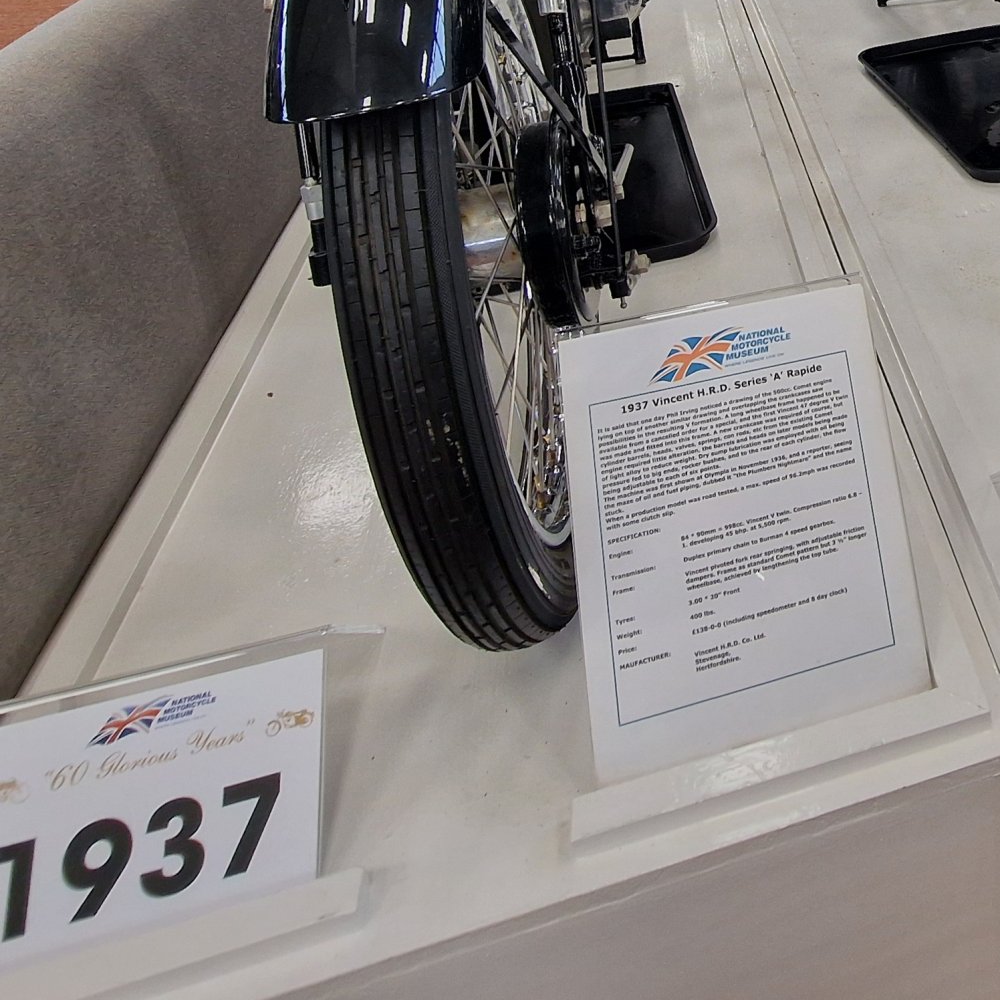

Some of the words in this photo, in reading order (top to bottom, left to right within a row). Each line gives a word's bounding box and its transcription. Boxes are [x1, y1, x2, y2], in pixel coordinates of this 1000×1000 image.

[731, 333, 791, 351] MOTORCYCLE
[738, 326, 785, 341] NATIONAL
[725, 345, 769, 360] MUSEUM
[620, 399, 649, 413] 1937
[651, 390, 694, 407] Vincent
[696, 382, 731, 397] H.R.D.
[733, 374, 767, 389] Series
[786, 363, 822, 379] Rapide
[622, 478, 655, 492] adjustable
[745, 514, 769, 524] Vincent
[792, 498, 831, 514] Compression
[688, 532, 724, 547] developing
[684, 565, 709, 577] Vincent
[709, 559, 734, 571] pivoted
[810, 531, 842, 545] adjustable
[842, 525, 865, 535] friction
[706, 545, 732, 557] primary
[746, 555, 774, 568] standard
[796, 544, 819, 556] pattern
[723, 569, 752, 581] achieved
[761, 556, 799, 572] lengthening
[722, 612, 755, 628] (including
[755, 601, 797, 618] speedometer
[693, 645, 719, 657] Vincent
[163, 696, 217, 715] MOTORCYCLE
[171, 690, 212, 706] NATIONAL
[157, 709, 194, 724] MUSEUM
[95, 749, 179, 781] Glorious
[0, 772, 281, 942] 1937
